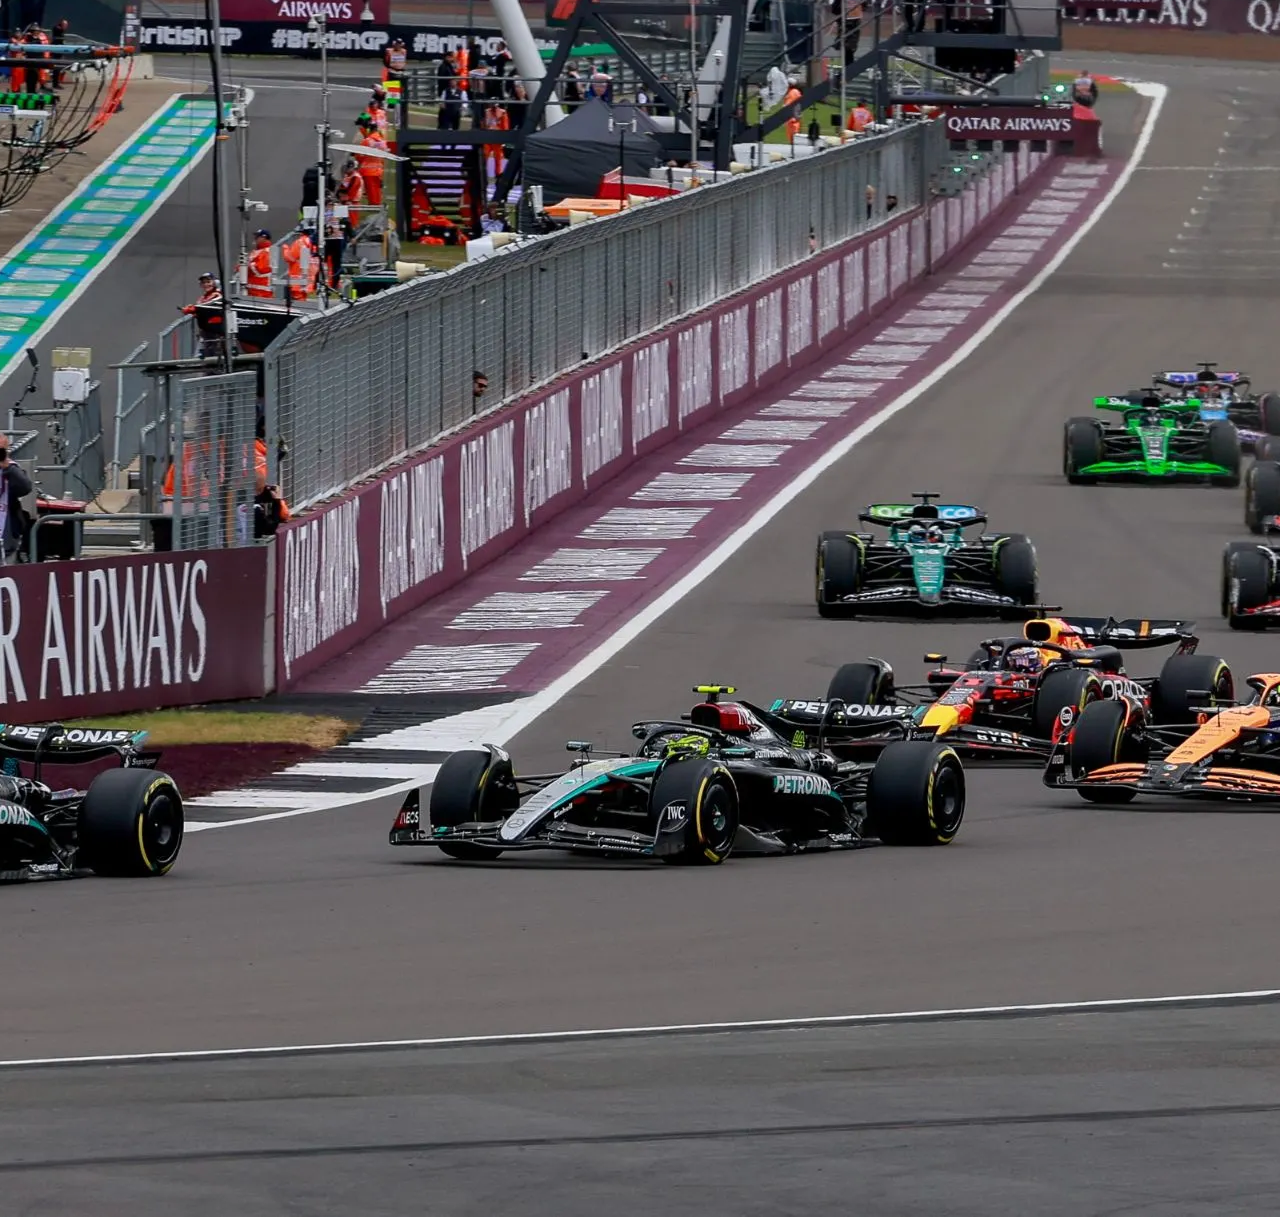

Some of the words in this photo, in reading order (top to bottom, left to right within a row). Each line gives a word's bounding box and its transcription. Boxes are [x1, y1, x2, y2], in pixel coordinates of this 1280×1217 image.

[277, 1, 353, 20] AIRWAYS
[947, 116, 1001, 134] QATAR
[1003, 117, 1072, 132] AIRWAYS
[42, 558, 209, 706] AIRWAYS
[790, 701, 910, 717] PETONAS
[10, 726, 128, 743] PEONAS
[667, 805, 686, 821] IWC
